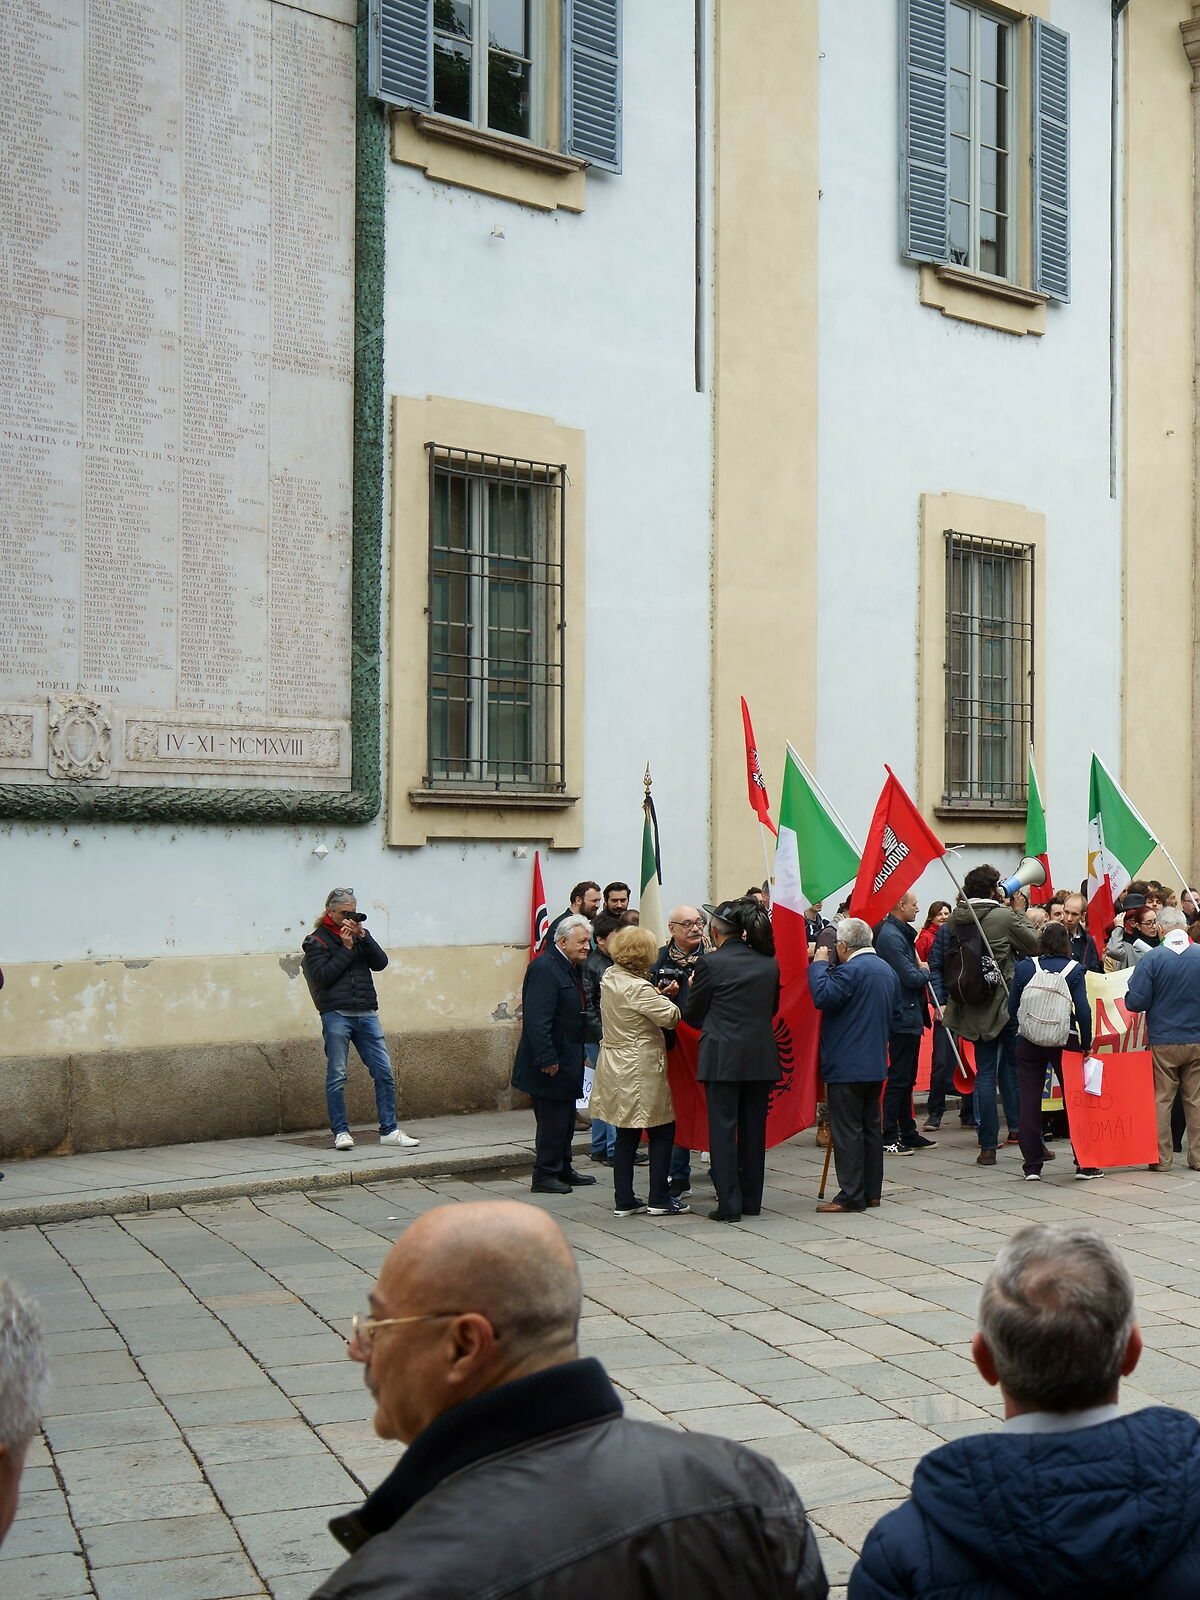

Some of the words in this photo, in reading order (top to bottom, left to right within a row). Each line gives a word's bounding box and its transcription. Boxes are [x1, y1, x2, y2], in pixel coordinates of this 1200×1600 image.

[4, 430, 56, 445] MALATTIA
[76, 441, 95, 451] PER
[100, 444, 148, 459] INCIDENTI
[153, 452, 162, 461] DI
[37, 681, 69, 690] MORTI
[94, 684, 120, 693] LIBIA
